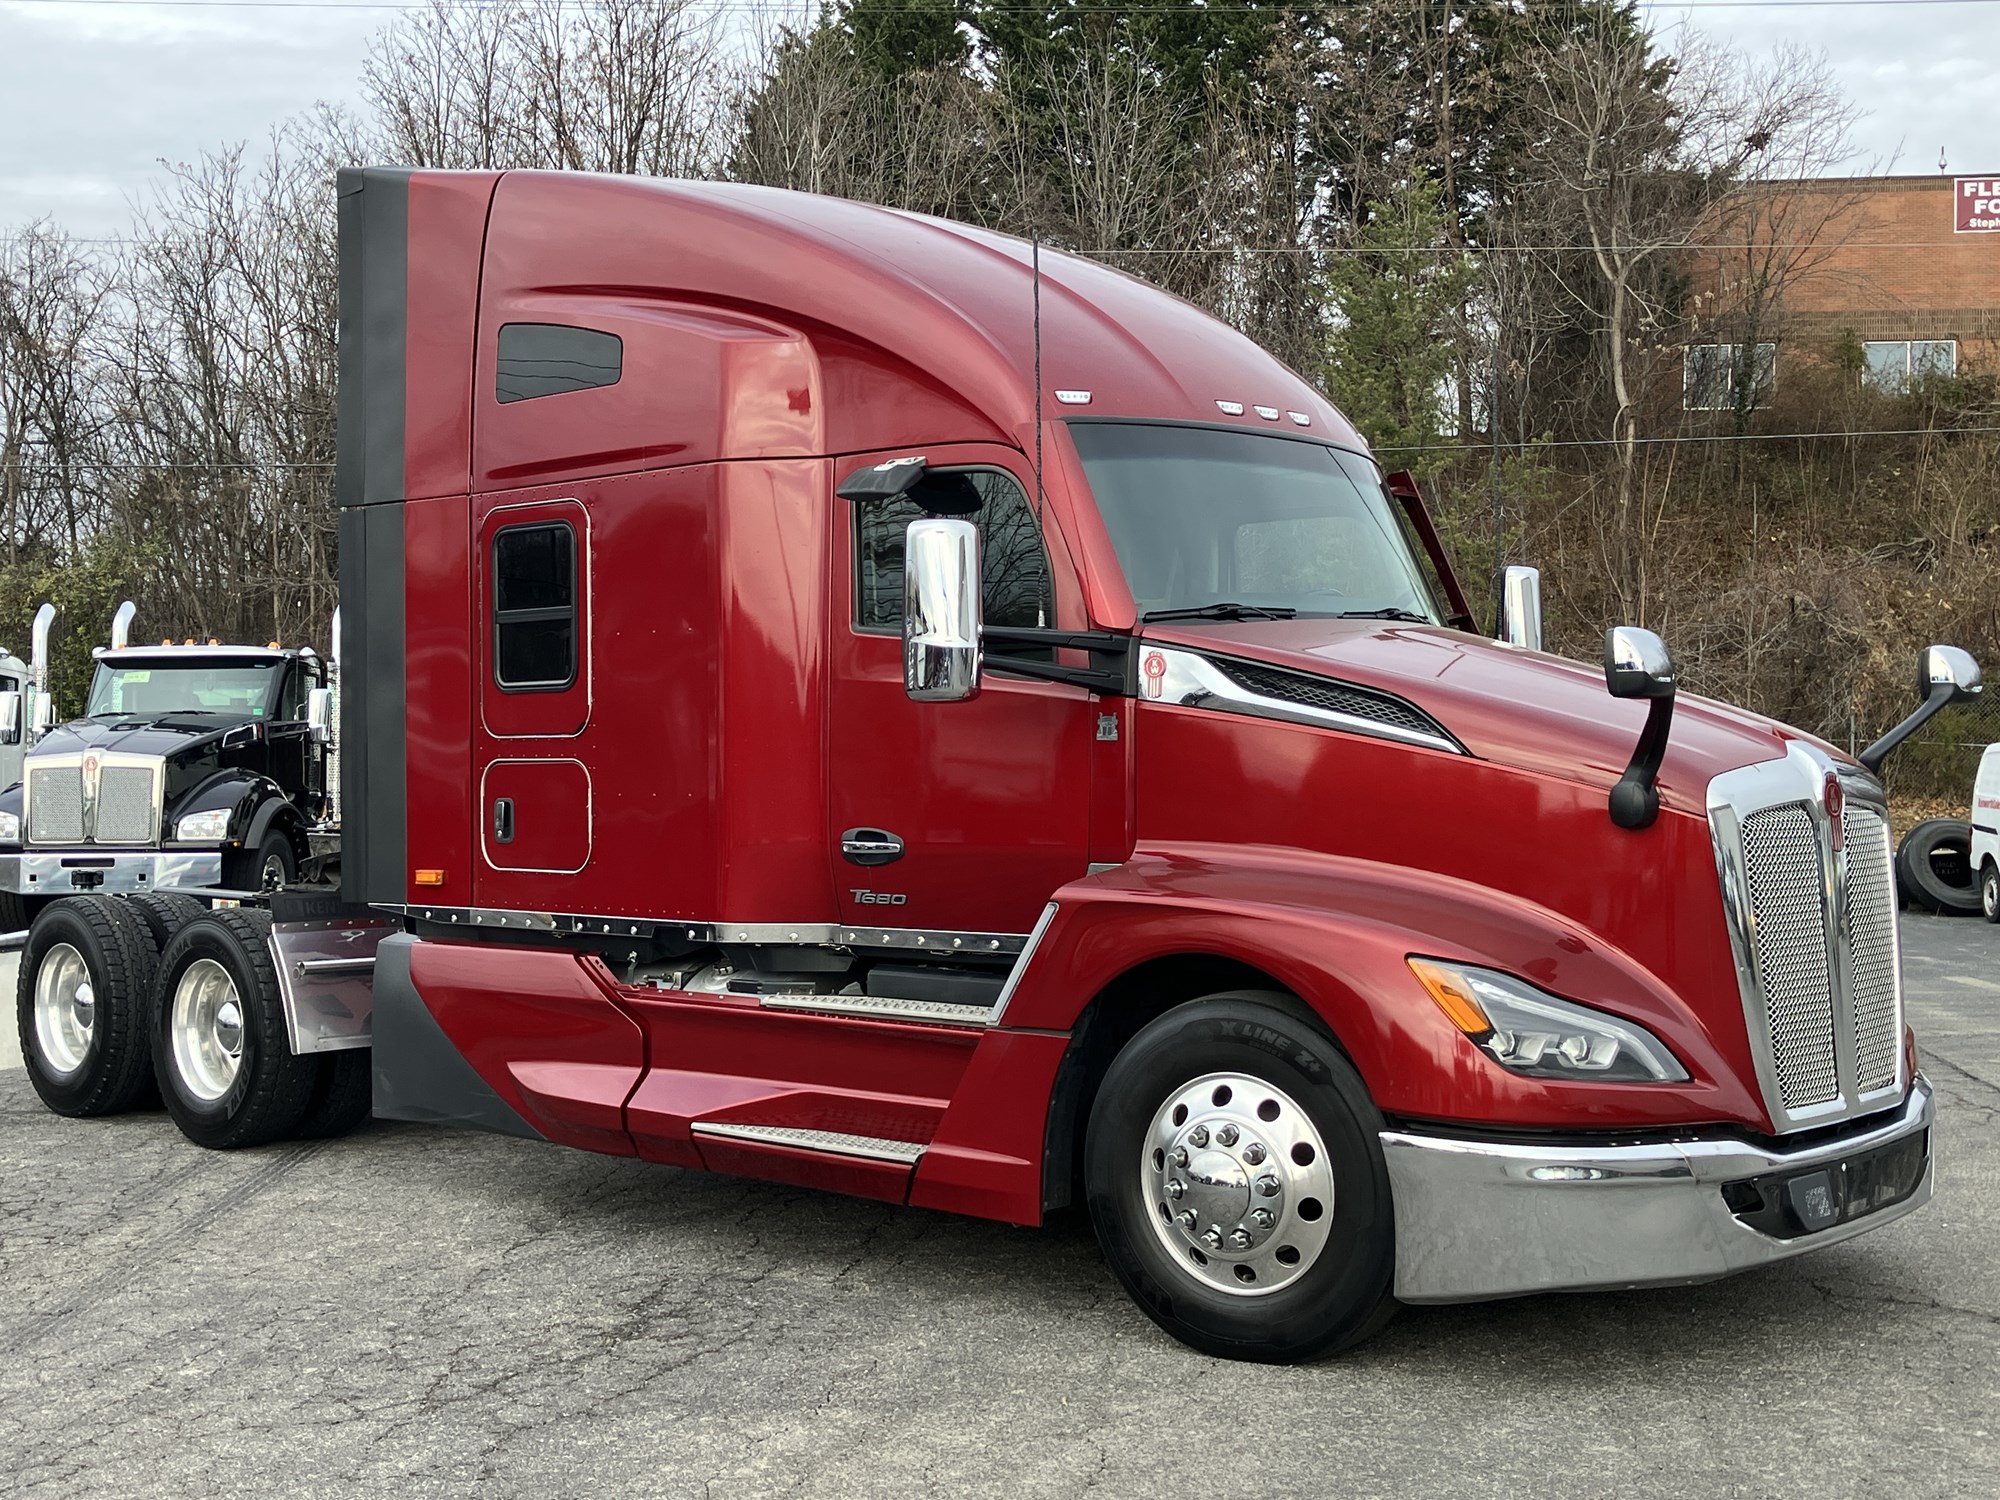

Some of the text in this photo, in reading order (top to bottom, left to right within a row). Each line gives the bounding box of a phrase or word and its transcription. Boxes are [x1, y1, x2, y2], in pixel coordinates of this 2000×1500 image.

[1964, 181, 2000, 197] FLE
[1974, 199, 2000, 214] FO
[849, 889, 907, 905] T680
[1242, 1024, 1292, 1050] LINE
